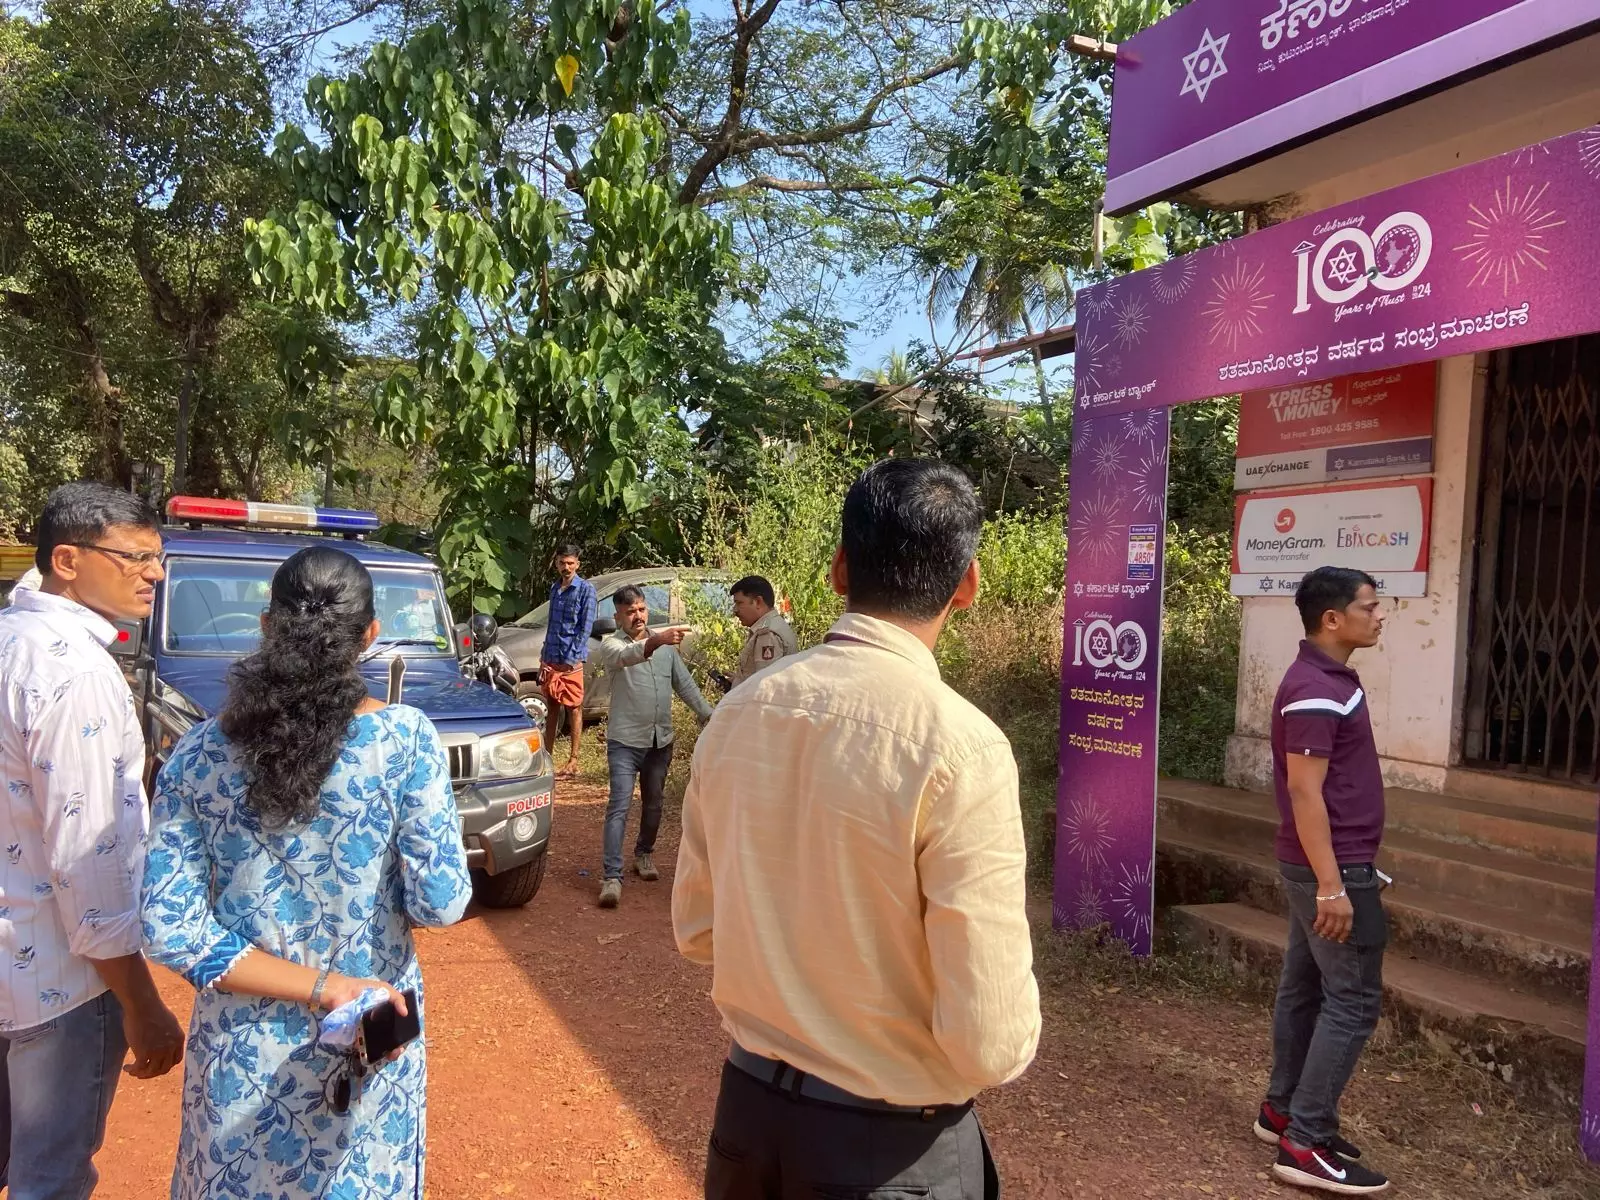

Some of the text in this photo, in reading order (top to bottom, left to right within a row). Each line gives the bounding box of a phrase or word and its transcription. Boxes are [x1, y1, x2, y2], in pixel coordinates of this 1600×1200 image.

[1312, 215, 1366, 236] Celebrating
[1291, 211, 1433, 315] 100
[1334, 293, 1405, 323] Years of Trust
[1218, 301, 1530, 381] ಶತಮಾನೋತ್ಸವ ವರ್ಷದ ಸಂಭ್ರಮಾಚರಣೆ
[1266, 382, 1334, 409] XPRESS
[1310, 425, 1332, 436] 1800
[1334, 422, 1352, 432] 425
[1255, 552, 1310, 562] money transfer
[1084, 610, 1113, 622] Celebrating
[1072, 618, 1148, 671] 100
[1094, 669, 1111, 680] Years
[1111, 670, 1118, 682] of
[1118, 670, 1133, 680] Trust
[1070, 685, 1144, 717] ಶತಮಾನೋತ್ಸವ
[1087, 712, 1124, 731] ವರ್ಷದ
[1068, 732, 1143, 758] ಸಂಭ್ರಮಾಚರಣೆ
[507, 791, 551, 816] POLICE
